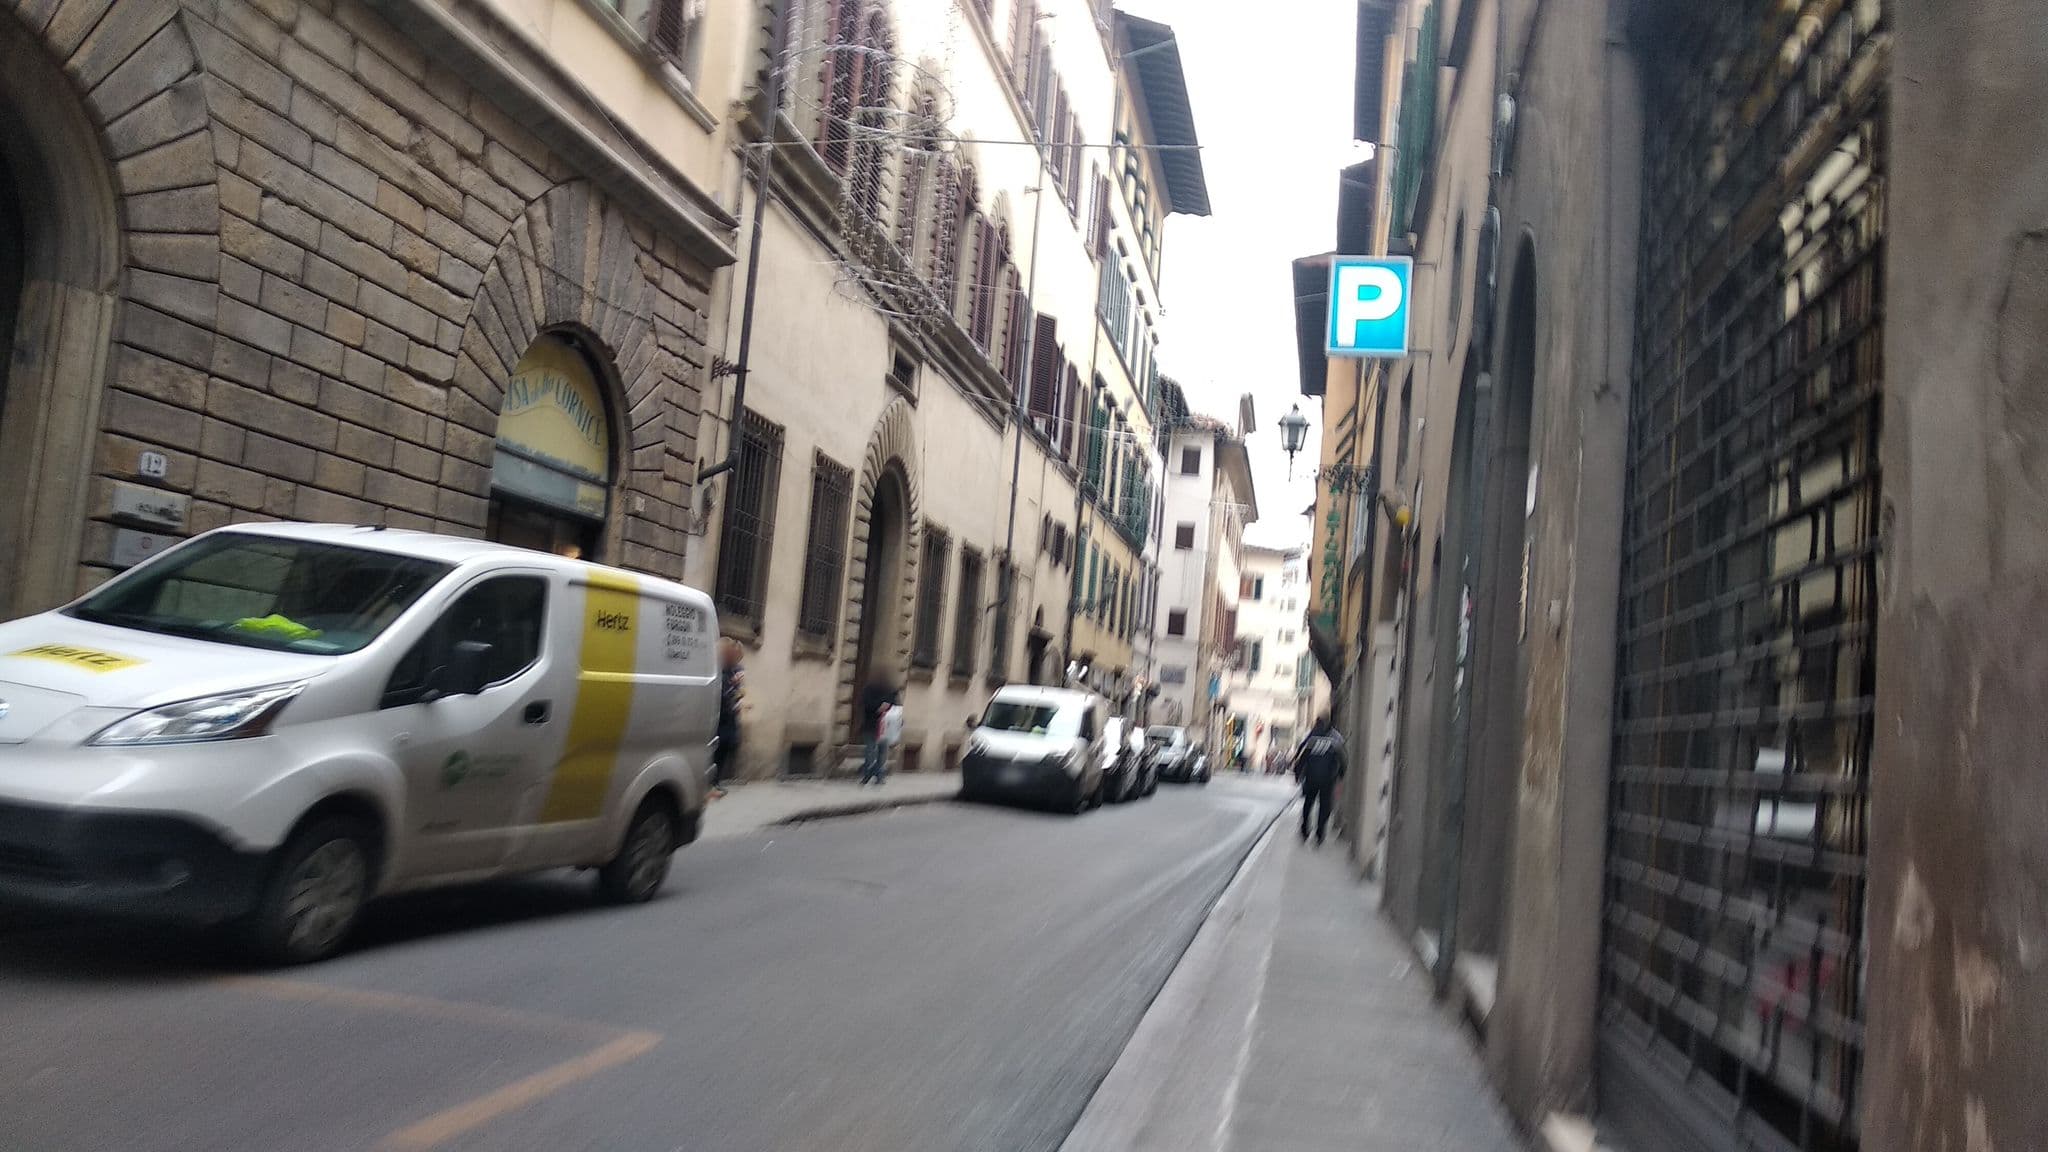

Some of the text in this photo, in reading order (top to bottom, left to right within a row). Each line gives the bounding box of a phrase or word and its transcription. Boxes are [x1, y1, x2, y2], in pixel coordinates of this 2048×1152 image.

[1337, 265, 1403, 347] P
[503, 377, 530, 411] ASA
[554, 378, 602, 446] CORNICE
[597, 609, 631, 630] Hertz
[22, 645, 122, 665] Hertz
